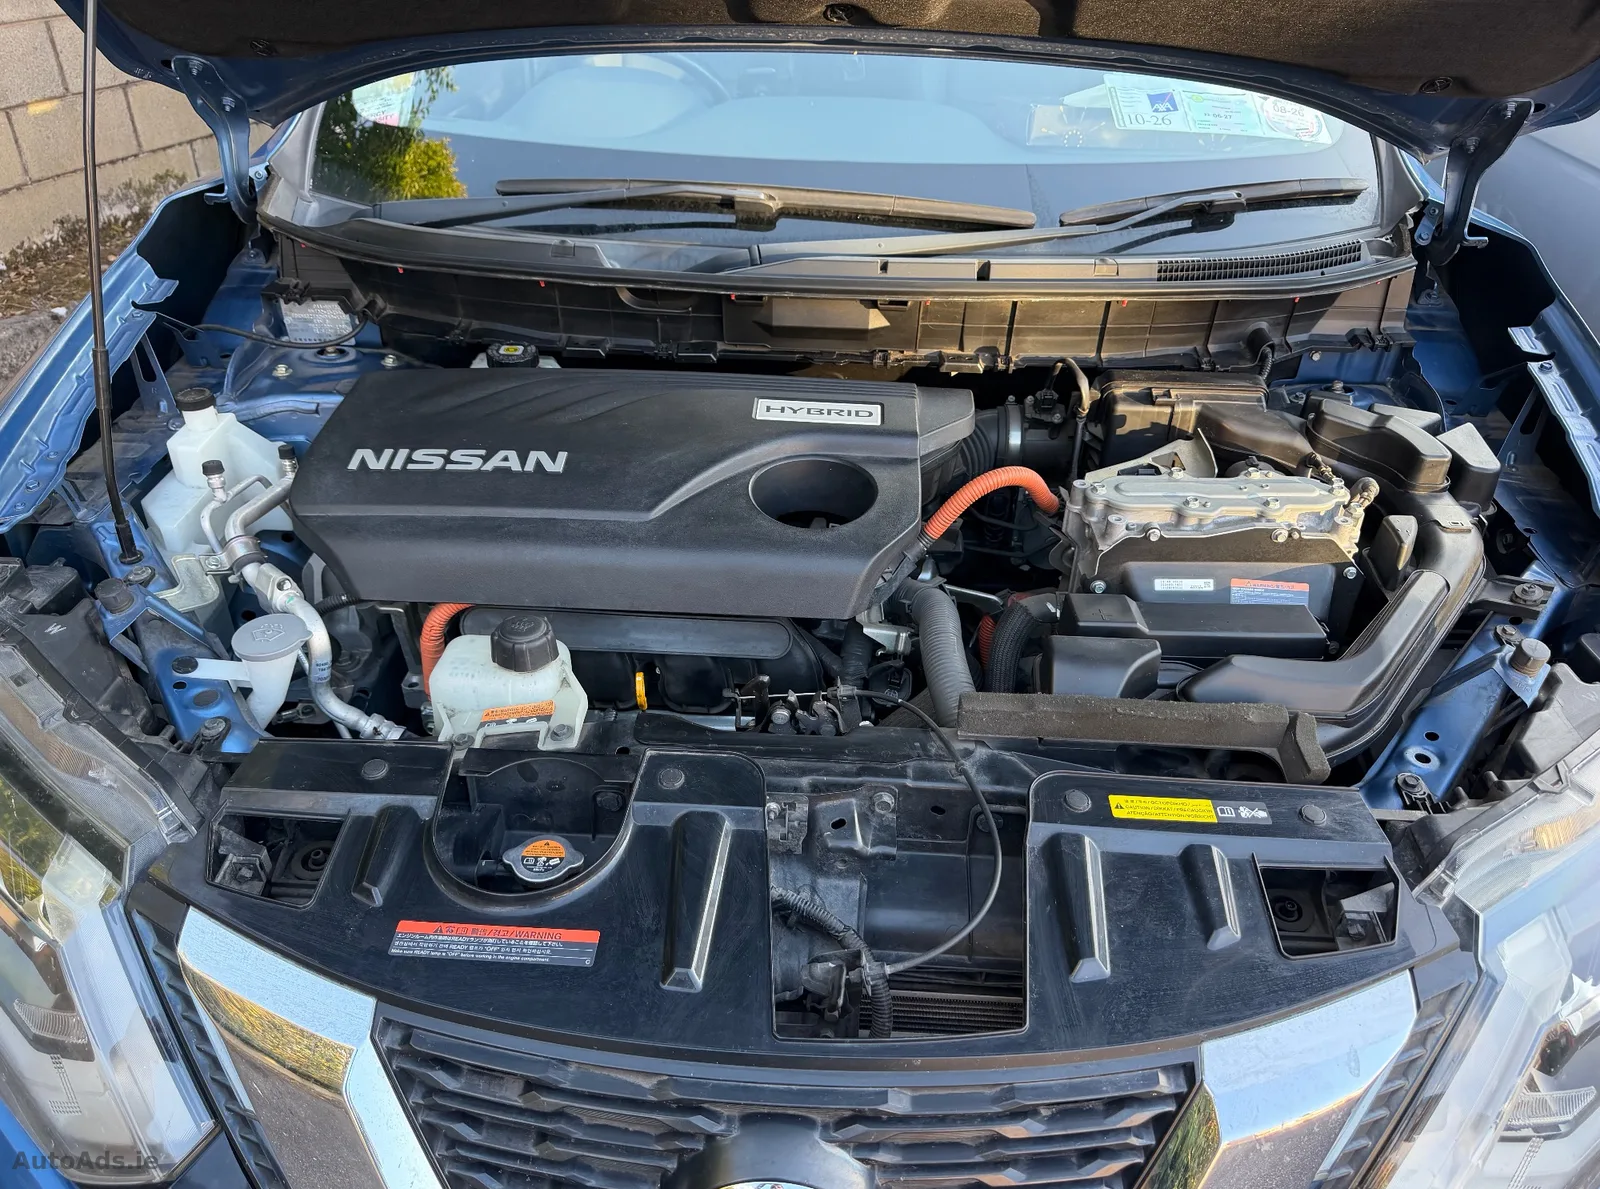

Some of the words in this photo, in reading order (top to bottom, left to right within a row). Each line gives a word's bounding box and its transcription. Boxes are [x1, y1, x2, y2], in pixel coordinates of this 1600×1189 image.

[1152, 103, 1174, 112] AXA
[1272, 102, 1305, 117] 08-26
[1127, 113, 1172, 126] 10-26
[764, 404, 874, 419] HYBRID
[346, 447, 568, 474] NISSAN
